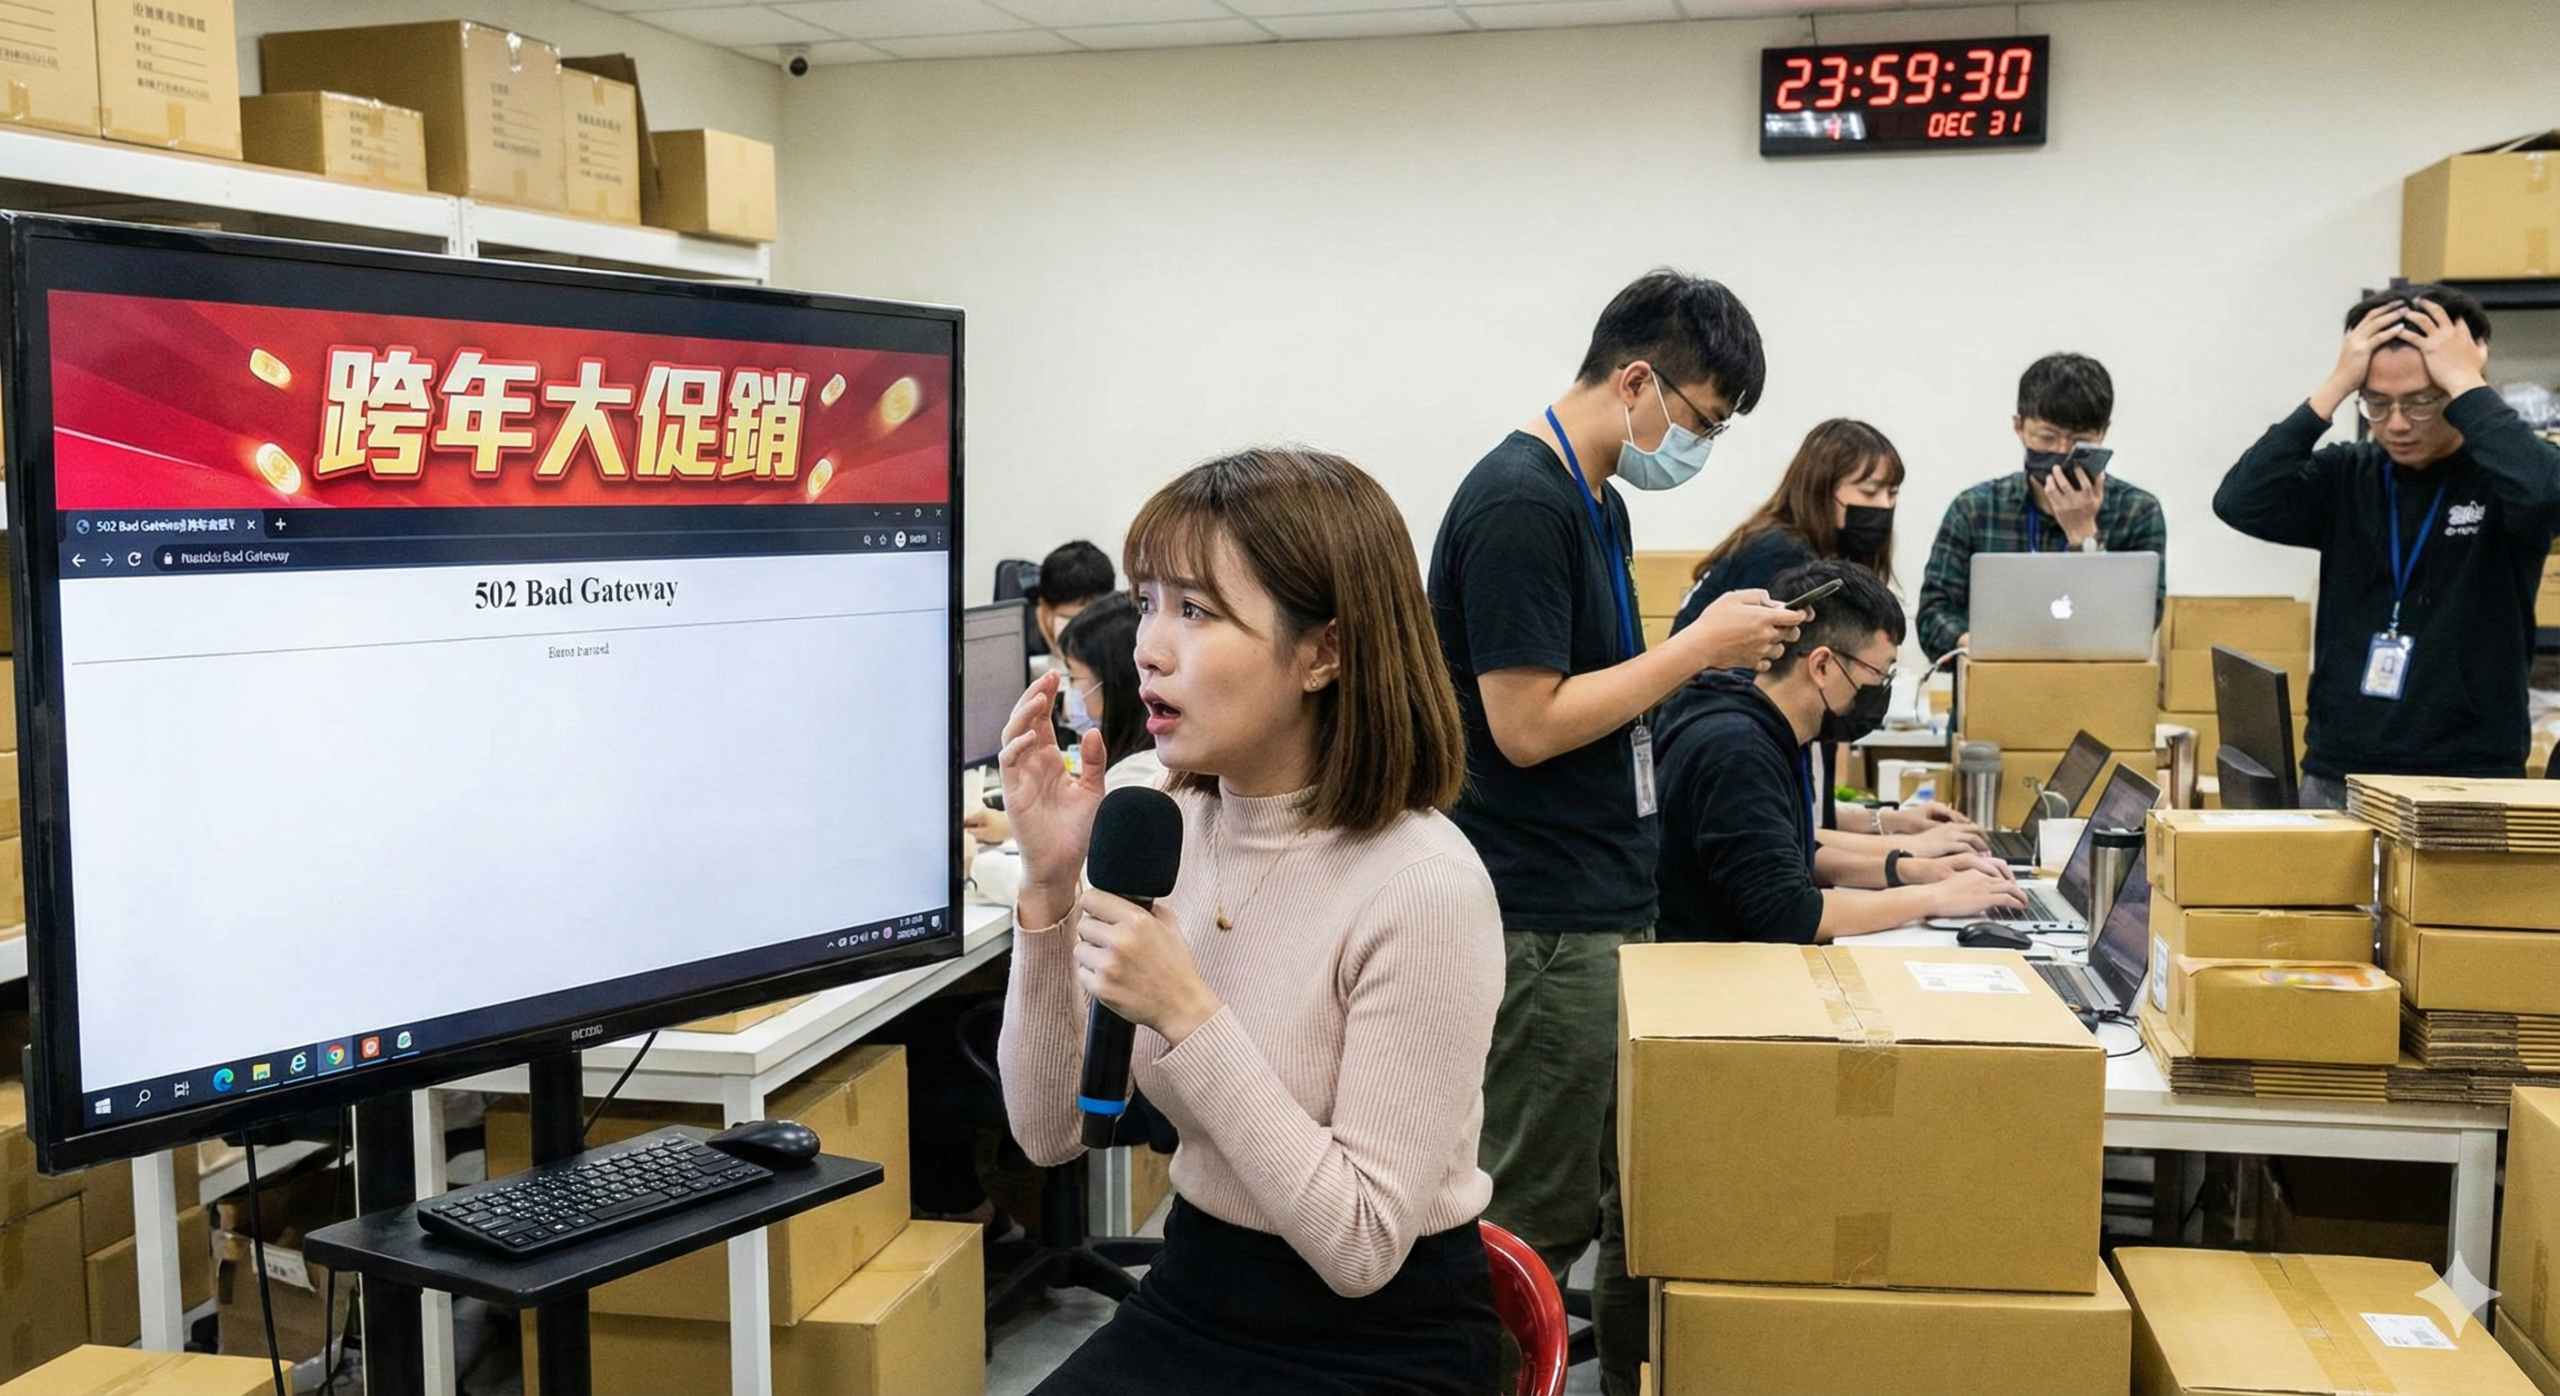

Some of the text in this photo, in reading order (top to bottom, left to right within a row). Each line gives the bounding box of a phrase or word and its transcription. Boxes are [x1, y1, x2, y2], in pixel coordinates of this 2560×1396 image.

[1776, 48, 2033, 110] 23:59:30
[1927, 111, 1977, 138] DEC
[1988, 110, 2023, 136] 31
[317, 349, 808, 477] 跨年大促銷
[97, 520, 117, 532] 502
[119, 519, 139, 532] Bad
[475, 577, 678, 609] 502 Bad Gateway
